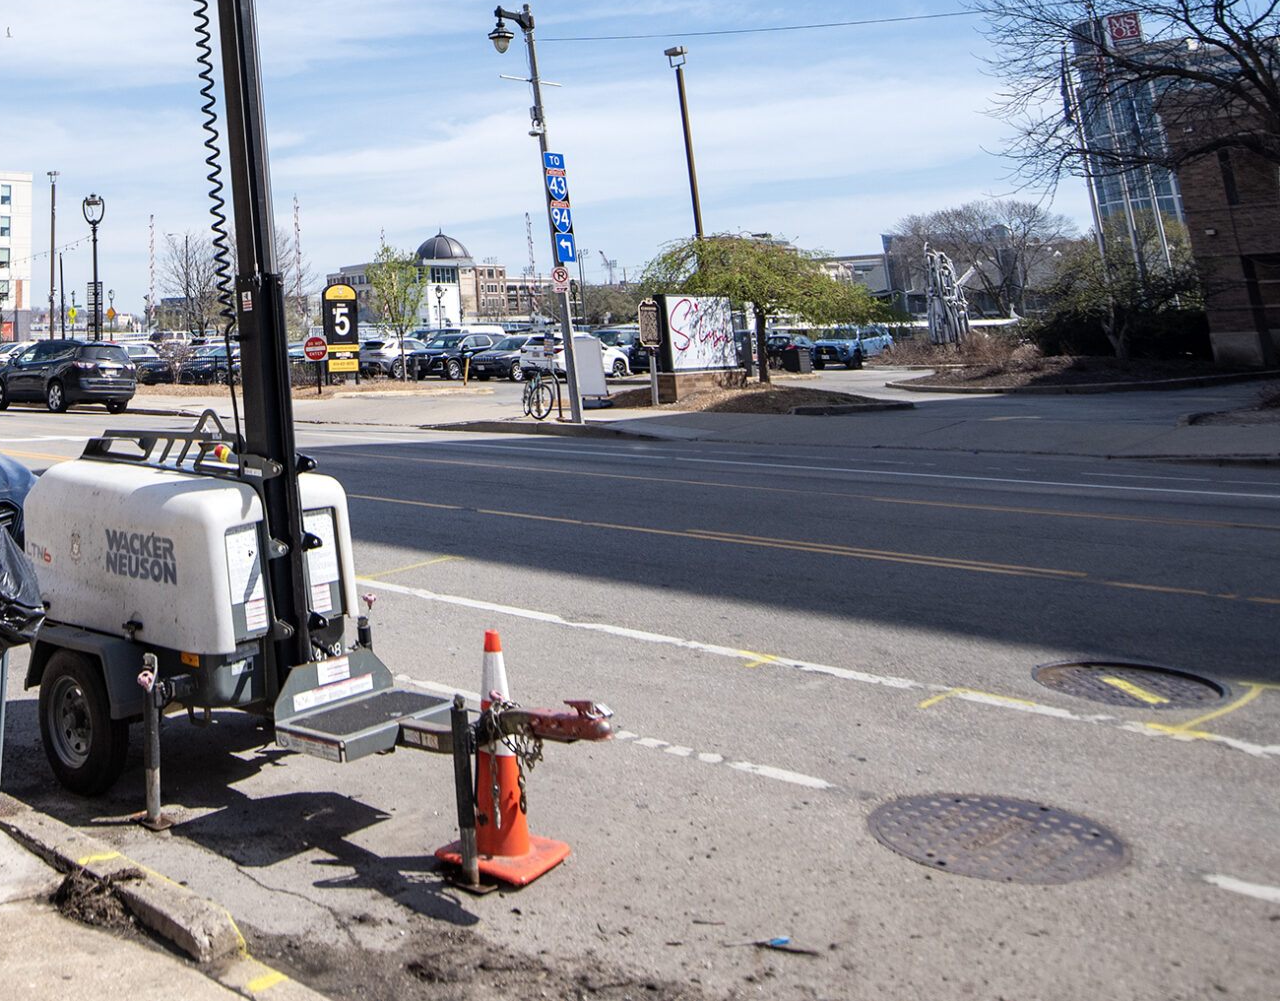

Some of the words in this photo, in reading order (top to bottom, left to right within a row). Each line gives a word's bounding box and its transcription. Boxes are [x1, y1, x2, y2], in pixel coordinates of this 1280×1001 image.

[549, 155, 560, 166] TO
[550, 176, 566, 195] 43
[552, 208, 570, 227] 94
[26, 541, 52, 563] LTN6
[105, 528, 177, 561] WACKER
[106, 551, 178, 586] NEUSON
